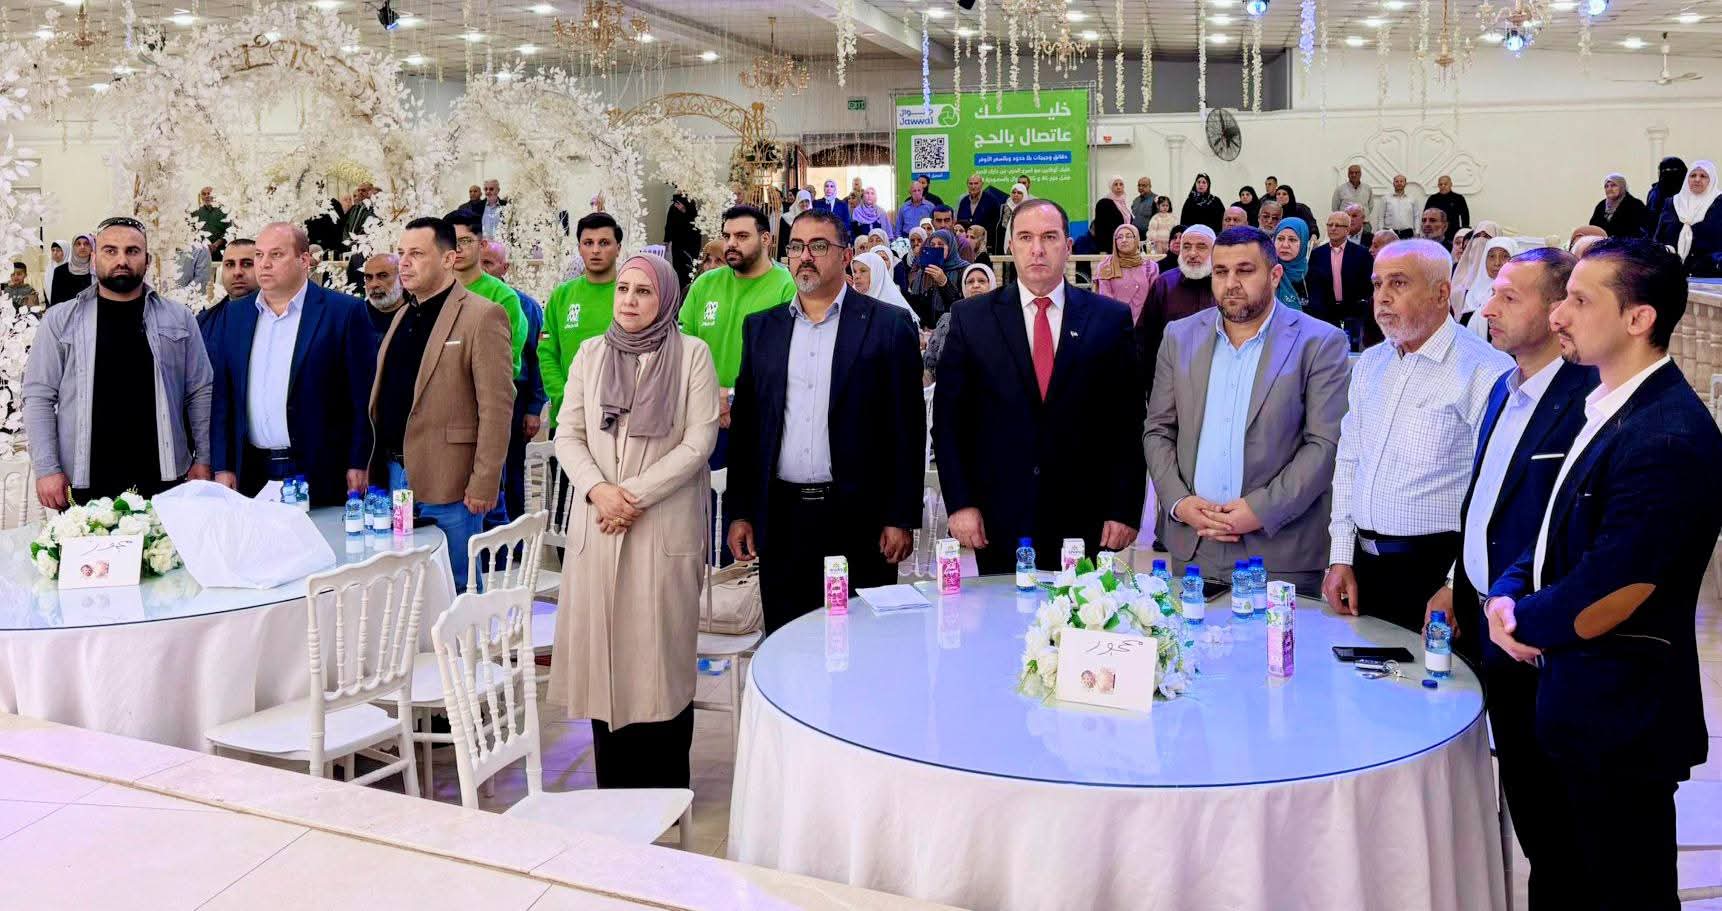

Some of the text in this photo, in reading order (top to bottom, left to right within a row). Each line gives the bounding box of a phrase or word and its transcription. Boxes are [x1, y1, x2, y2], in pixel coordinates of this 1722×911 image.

[899, 117, 934, 125] Jawwal
[974, 127, 1072, 148] عاتصال بالحج
